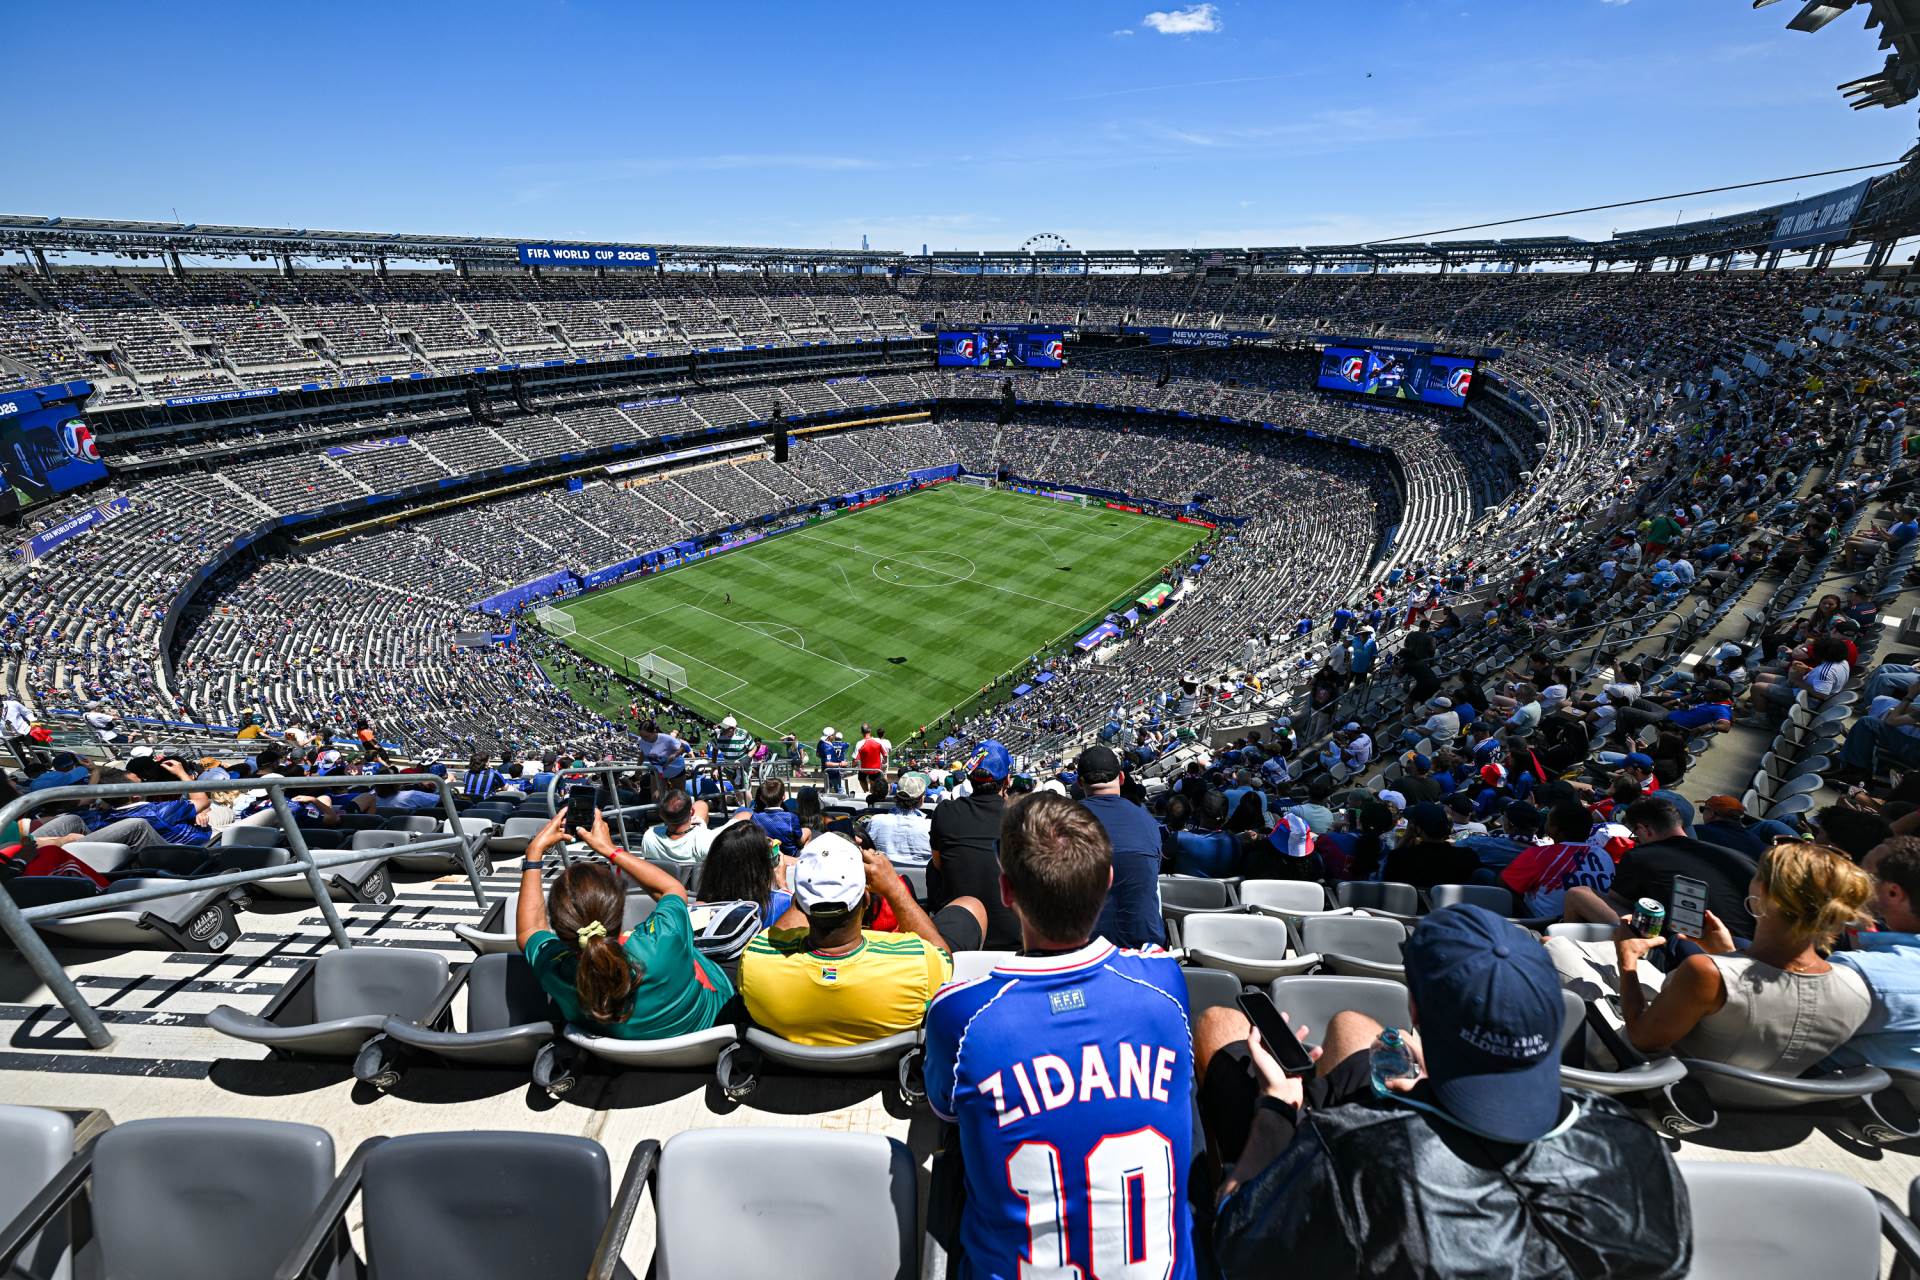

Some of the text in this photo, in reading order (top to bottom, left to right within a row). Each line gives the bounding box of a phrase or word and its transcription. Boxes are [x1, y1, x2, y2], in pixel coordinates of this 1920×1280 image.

[527, 248, 650, 260] FIFA WORLD CUP 2026
[1200, 332, 1229, 340] YORK
[172, 389, 274, 405] NEW YORK NEW JERSEY
[41, 512, 93, 542] FIFA WORLD CUP 2026
[376, 894, 385, 903] 20
[213, 935, 225, 946] 21
[1459, 1028, 1521, 1058] ELDEST
[1481, 1031, 1509, 1047] AM
[978, 1042, 1176, 1128] ZIDANE
[1006, 1126, 1177, 1280] 10
